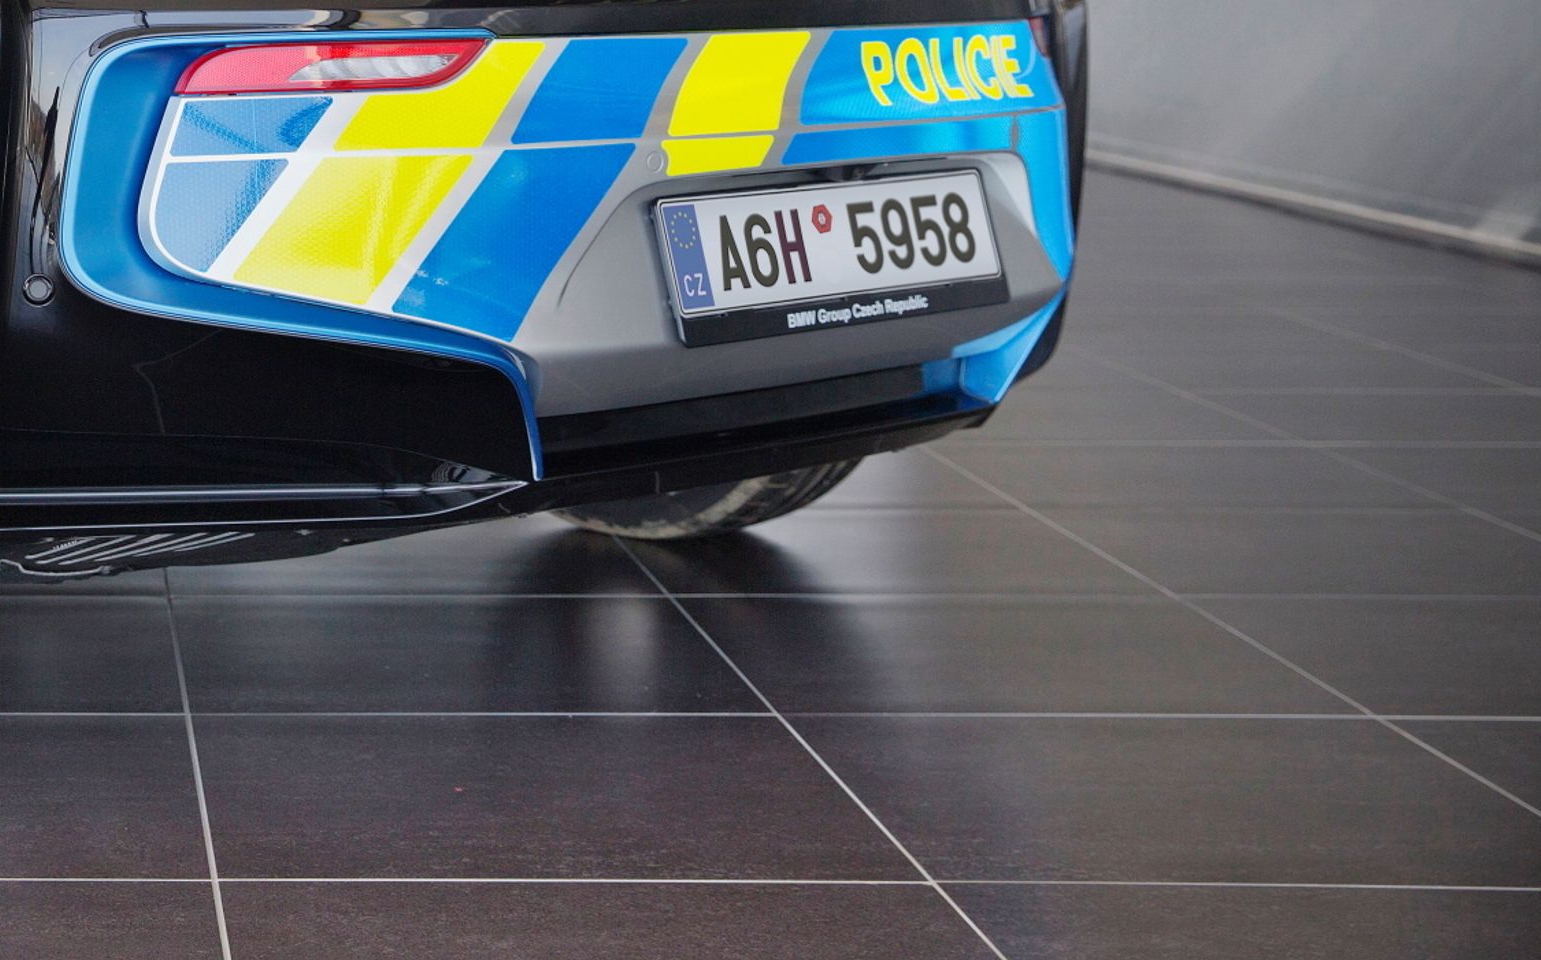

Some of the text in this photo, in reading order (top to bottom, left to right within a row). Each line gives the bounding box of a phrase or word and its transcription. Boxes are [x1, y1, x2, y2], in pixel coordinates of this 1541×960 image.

[861, 34, 1035, 106] POLICE
[719, 192, 976, 291] A6H 5958
[683, 273, 707, 297] CZ
[787, 294, 929, 328] BMW Group Czech Republic
